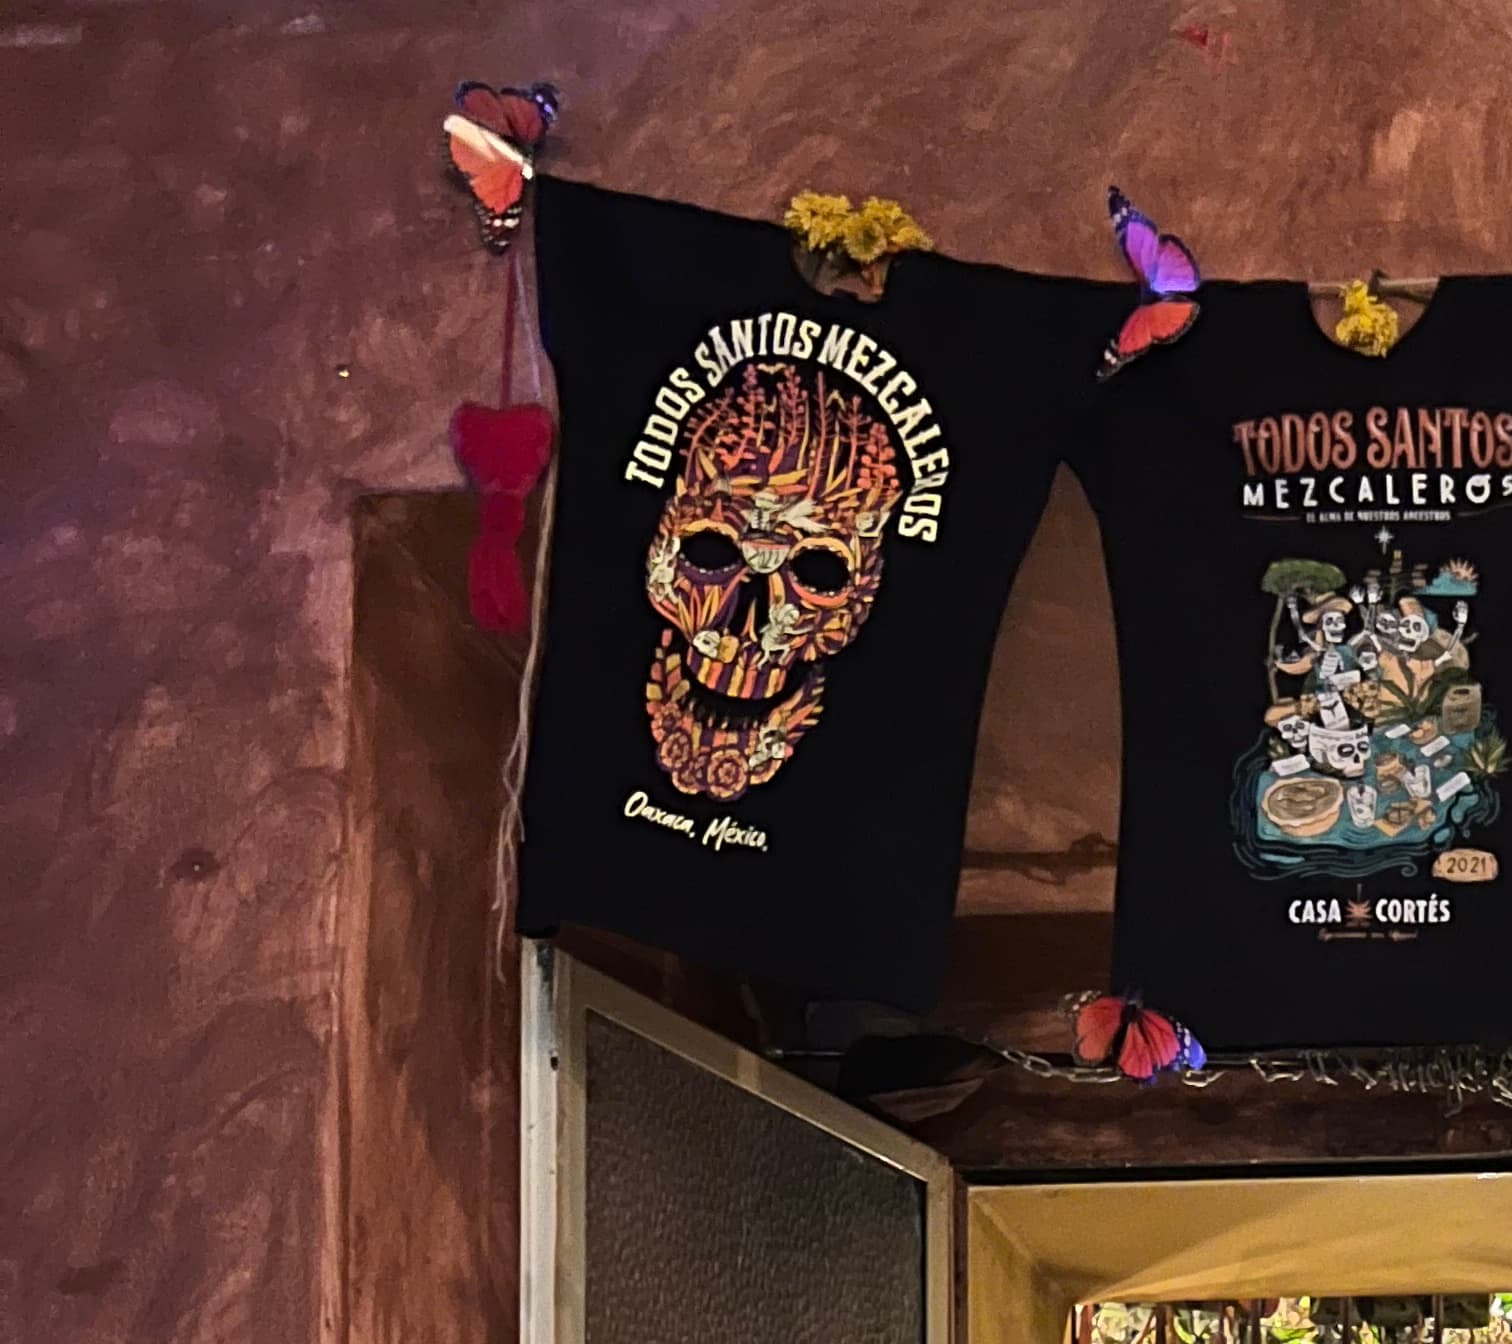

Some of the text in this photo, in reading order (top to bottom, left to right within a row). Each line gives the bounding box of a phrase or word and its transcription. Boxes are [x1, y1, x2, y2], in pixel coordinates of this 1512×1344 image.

[625, 312, 950, 542] TODOS SANTOS MEZCALEROS
[1232, 409, 1357, 476] TODOS
[1446, 857, 1487, 874] 2021
[1288, 893, 1451, 923] CASA CORTÉS
